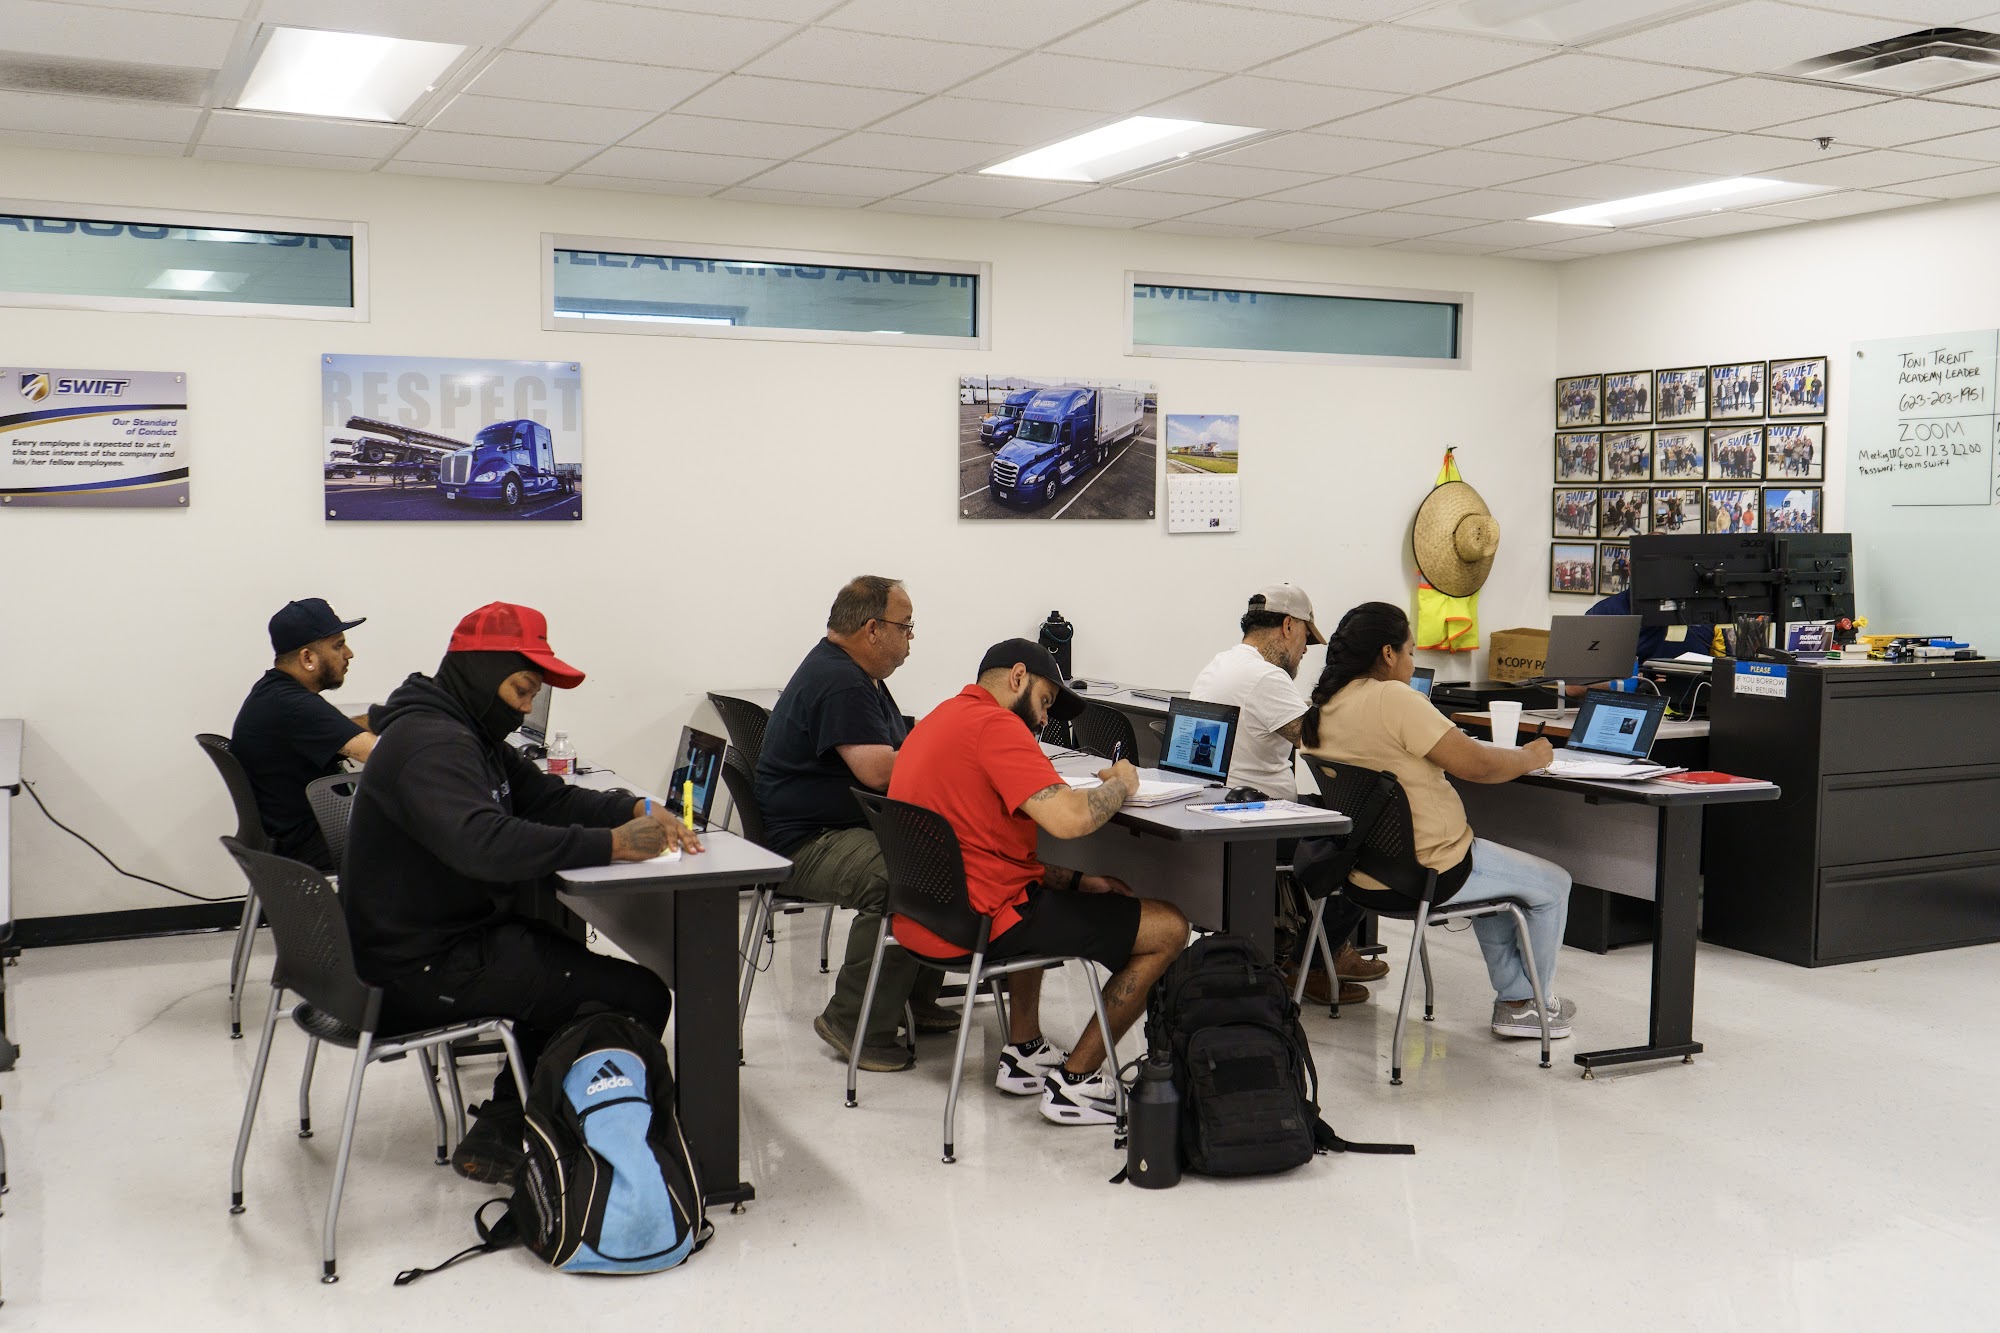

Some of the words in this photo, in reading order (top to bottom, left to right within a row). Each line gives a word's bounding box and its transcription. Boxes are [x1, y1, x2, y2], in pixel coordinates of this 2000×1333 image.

[1783, 363, 1817, 378] SWIFT
[1945, 367, 1981, 380] LEADER
[57, 379, 127, 395] SWIFT
[322, 370, 581, 431] RESPECT
[112, 418, 130, 426] Our
[133, 418, 178, 427] Standard
[126, 428, 136, 436] of
[138, 428, 178, 436] Conduct
[1898, 421, 1965, 441] ZOOM
[12, 439, 37, 448] Every
[39, 440, 81, 448] employee
[1728, 431, 1762, 447] SWIFT
[77, 460, 125, 468] employees.
[1504, 657, 1533, 669] COPY
[1750, 665, 1771, 674] PLEASE
[1743, 676, 1754, 684] YOU
[1756, 677, 1784, 686] BORROW
[1756, 686, 1777, 695] RETURN
[586, 1076, 633, 1095] adidas
